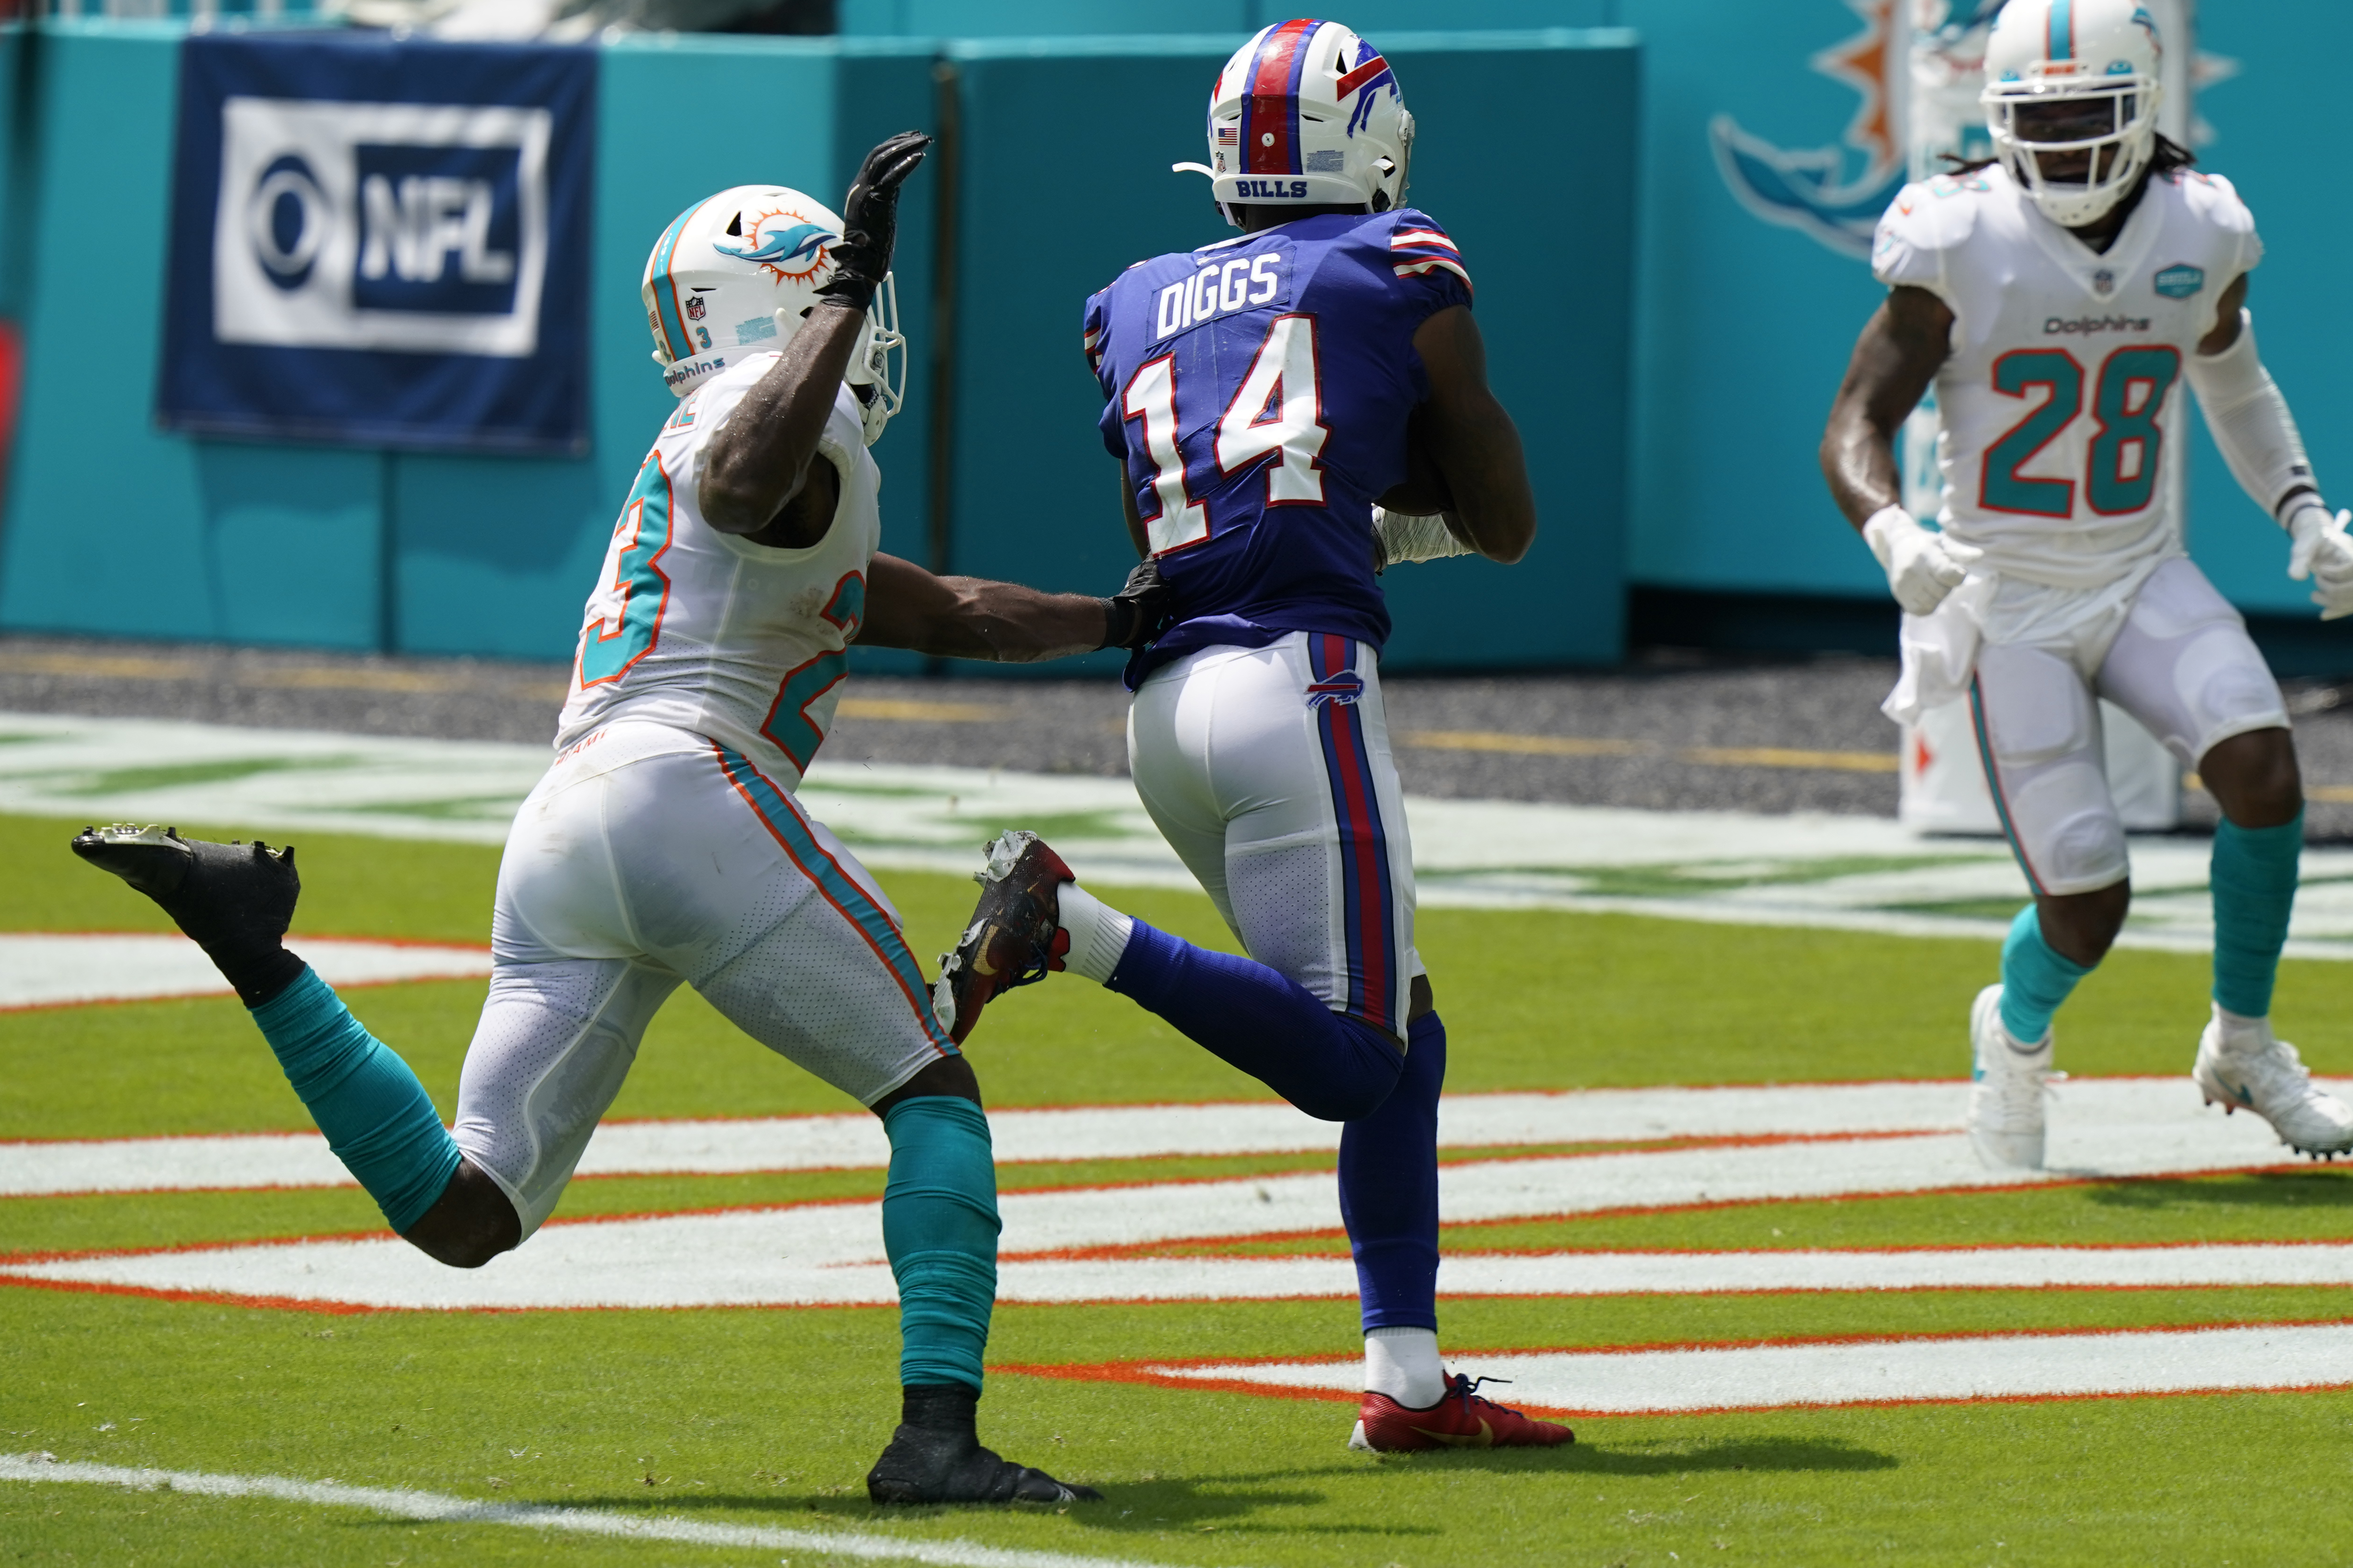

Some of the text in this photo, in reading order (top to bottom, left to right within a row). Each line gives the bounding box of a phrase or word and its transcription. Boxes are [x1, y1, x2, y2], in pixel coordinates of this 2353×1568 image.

[1236, 181, 1307, 198] BILLS
[361, 174, 515, 283] NFL
[688, 306, 704, 318] NFL
[1156, 252, 1280, 339] DIGGS
[2044, 314, 2151, 339] Dolphins
[665, 357, 726, 387] Dolphins
[1121, 311, 1333, 559] 14
[1978, 344, 2183, 520] 28
